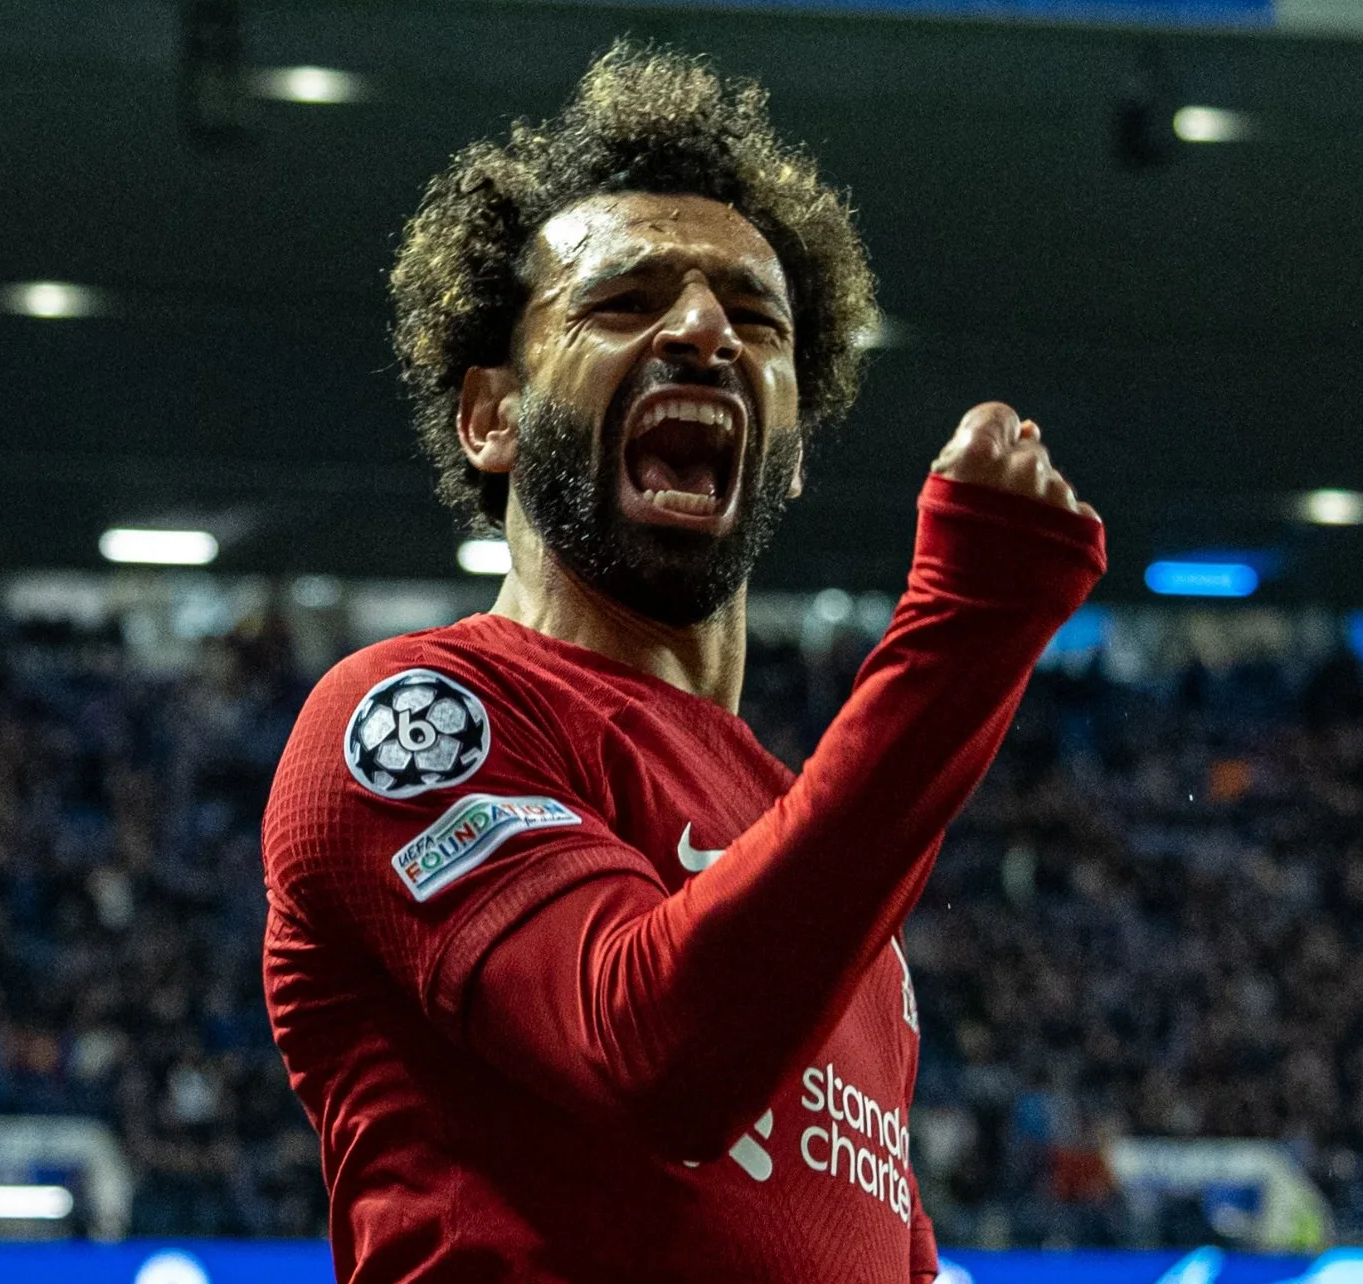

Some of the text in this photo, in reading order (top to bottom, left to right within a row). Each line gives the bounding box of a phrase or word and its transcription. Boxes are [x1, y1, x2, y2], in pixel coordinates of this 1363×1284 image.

[398, 834, 435, 868] UEFA
[405, 802, 566, 883] FOUNDATION
[801, 1063, 910, 1170] standa
[800, 1120, 912, 1229] charte
